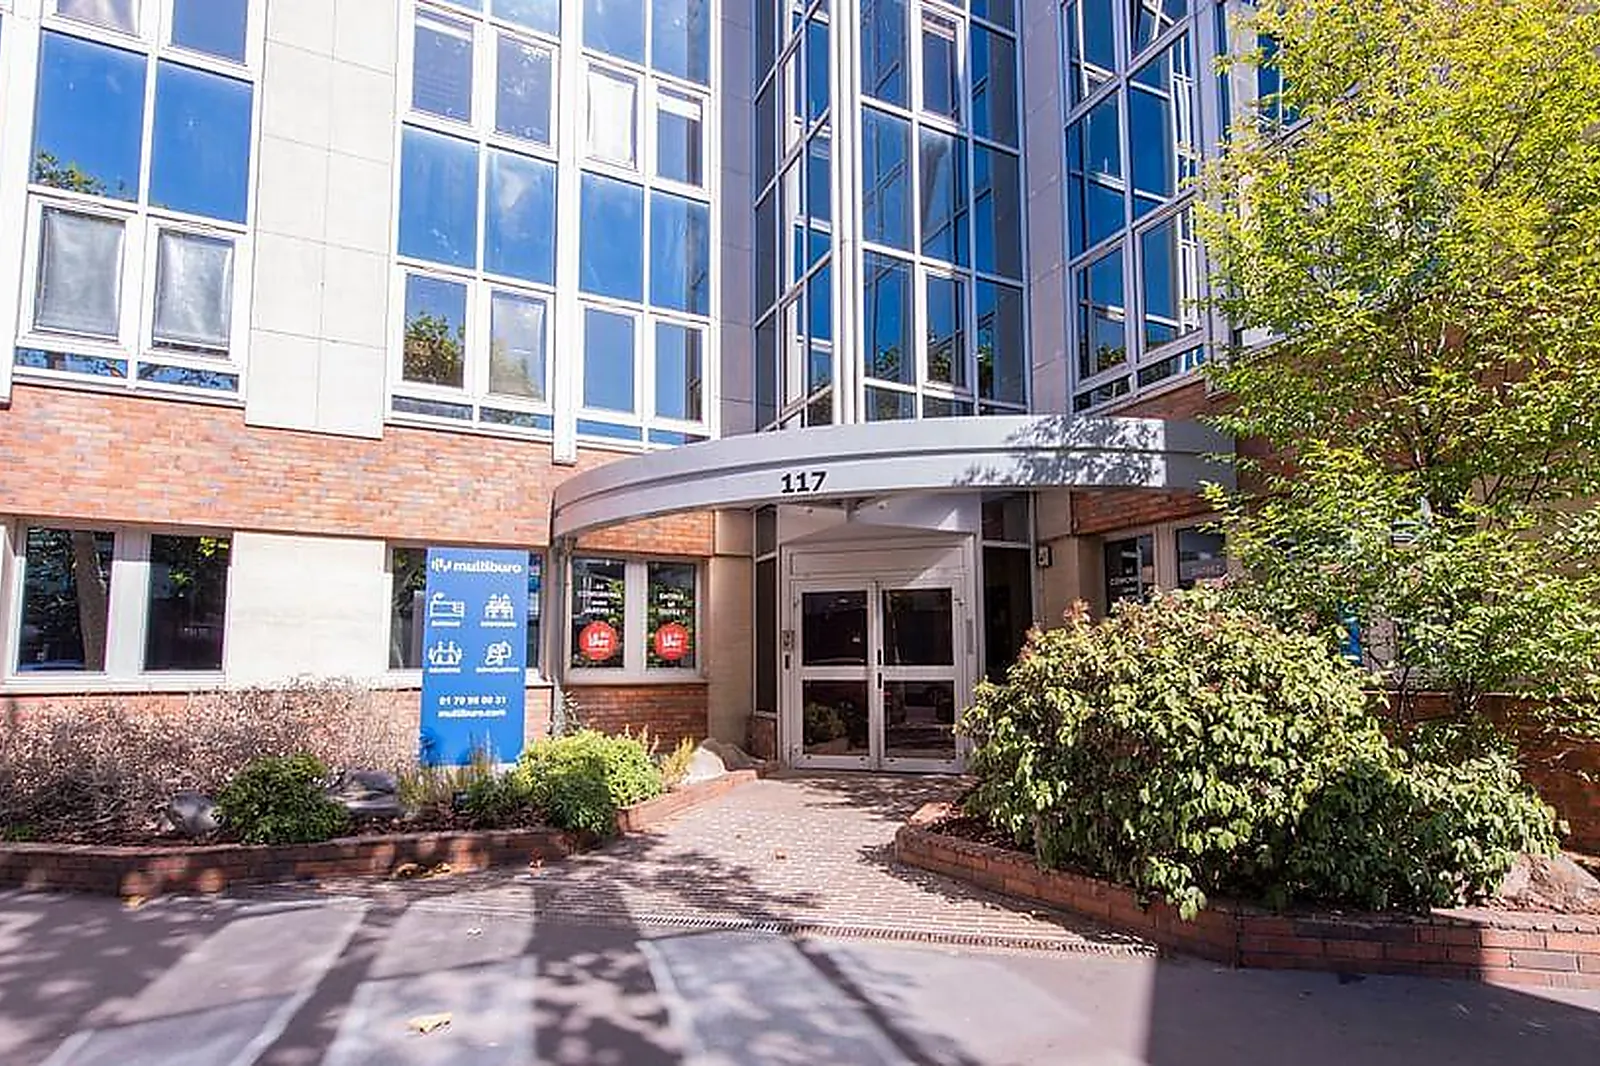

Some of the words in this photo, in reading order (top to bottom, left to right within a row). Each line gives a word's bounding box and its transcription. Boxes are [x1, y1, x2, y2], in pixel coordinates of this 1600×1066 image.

[781, 471, 827, 493] 117
[453, 560, 522, 573] multiburo
[438, 709, 506, 718] multiburo.com
